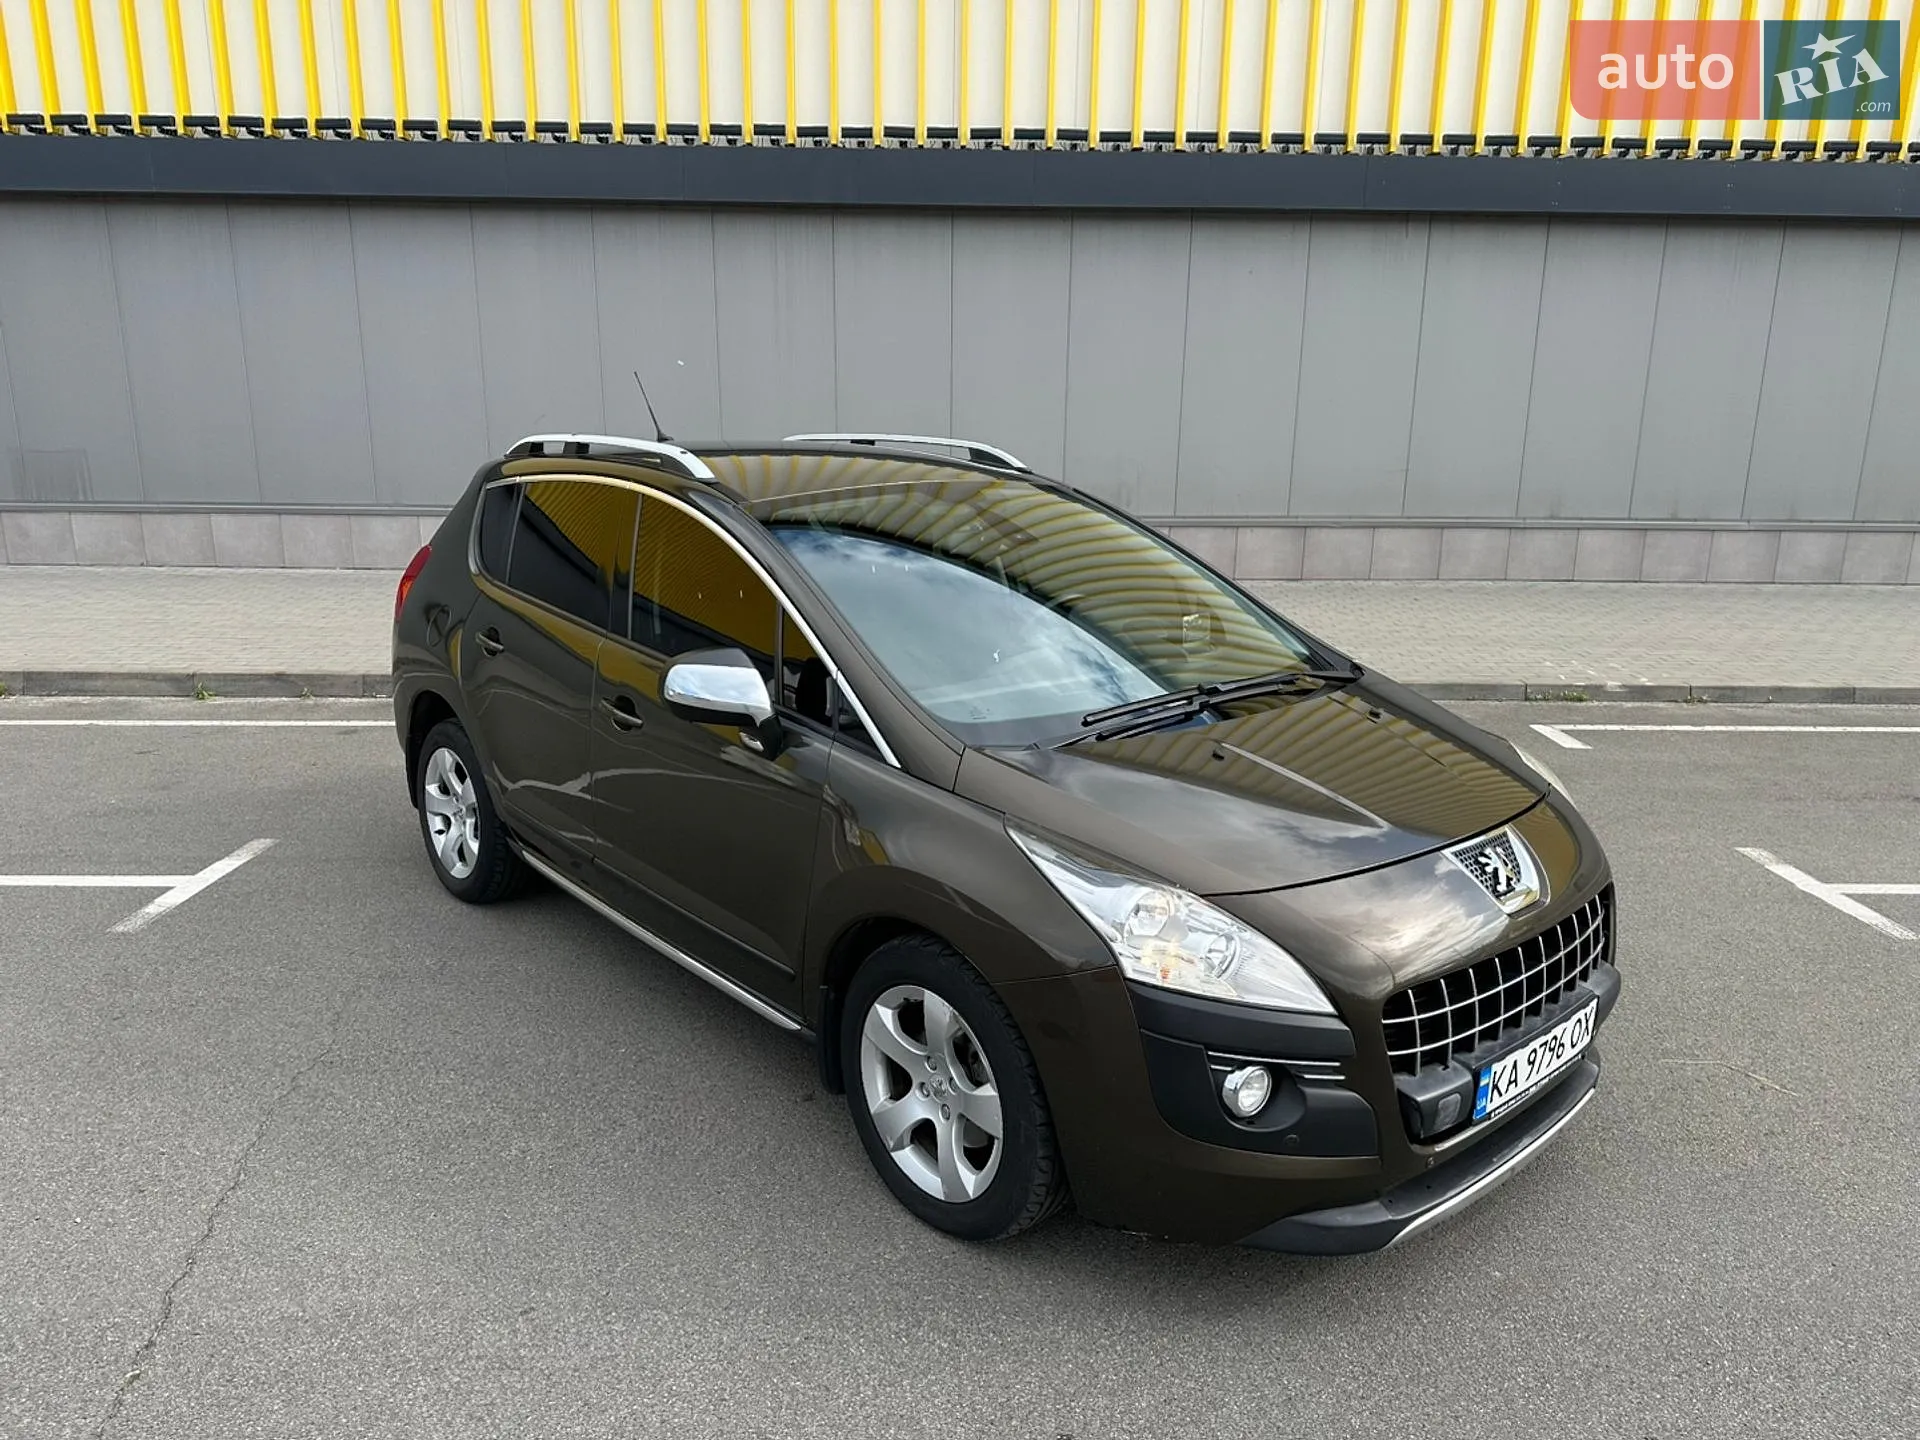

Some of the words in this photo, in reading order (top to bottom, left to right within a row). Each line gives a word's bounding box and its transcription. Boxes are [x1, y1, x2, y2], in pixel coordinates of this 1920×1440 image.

[1489, 1059, 1518, 1104] KA
[1525, 1027, 1567, 1082] 9796
[1570, 1006, 1594, 1049] OX
